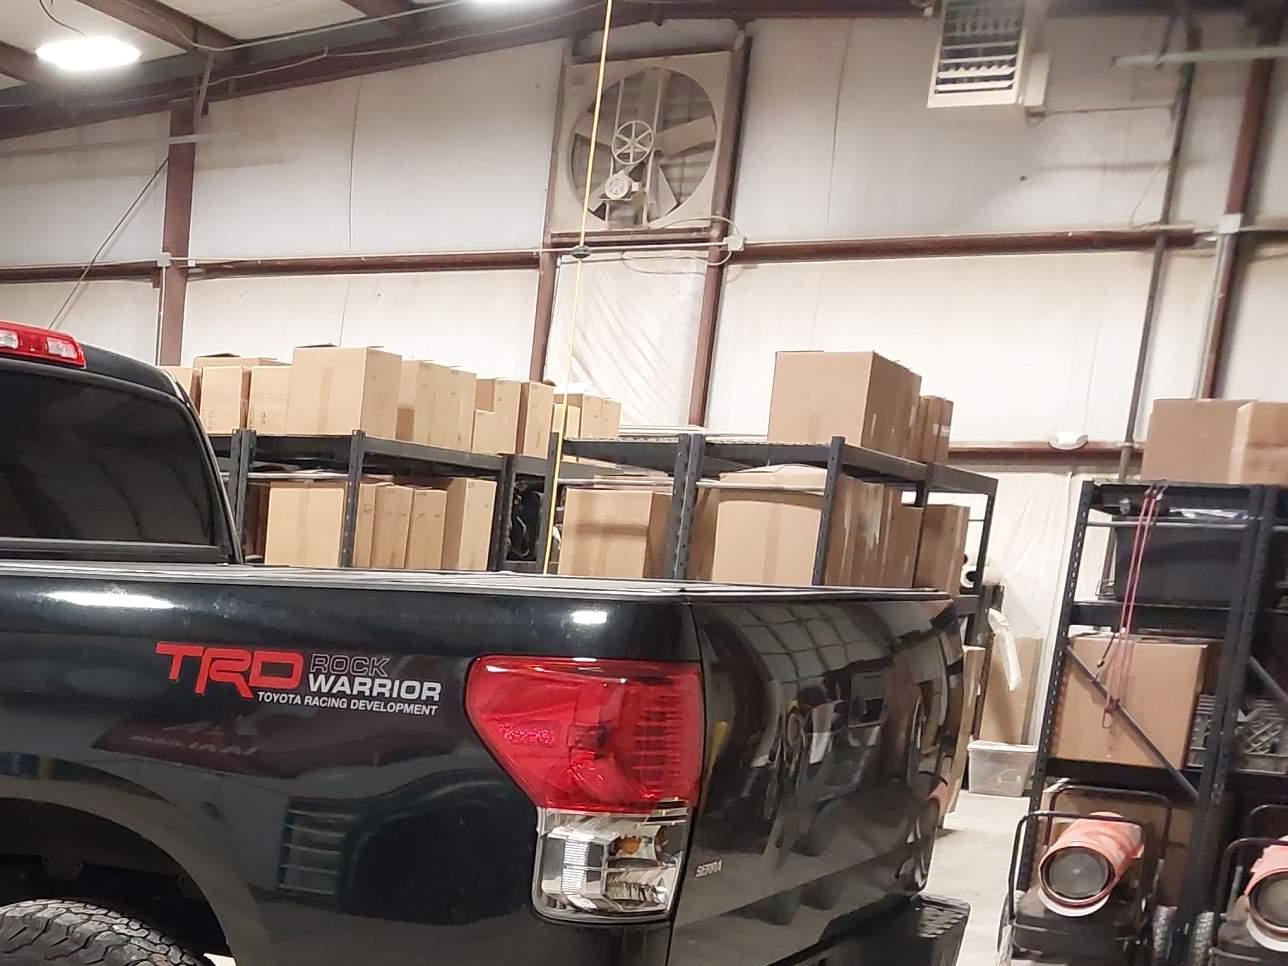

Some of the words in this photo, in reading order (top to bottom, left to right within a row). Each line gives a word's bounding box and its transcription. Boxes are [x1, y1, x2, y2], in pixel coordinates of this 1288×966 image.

[155, 641, 304, 699] TRD
[309, 653, 391, 678] ROCK
[307, 673, 442, 702] WARRIOR
[257, 691, 302, 706] TOYOTA
[303, 696, 348, 710] RACING
[350, 699, 440, 717] DEVELOPMENT
